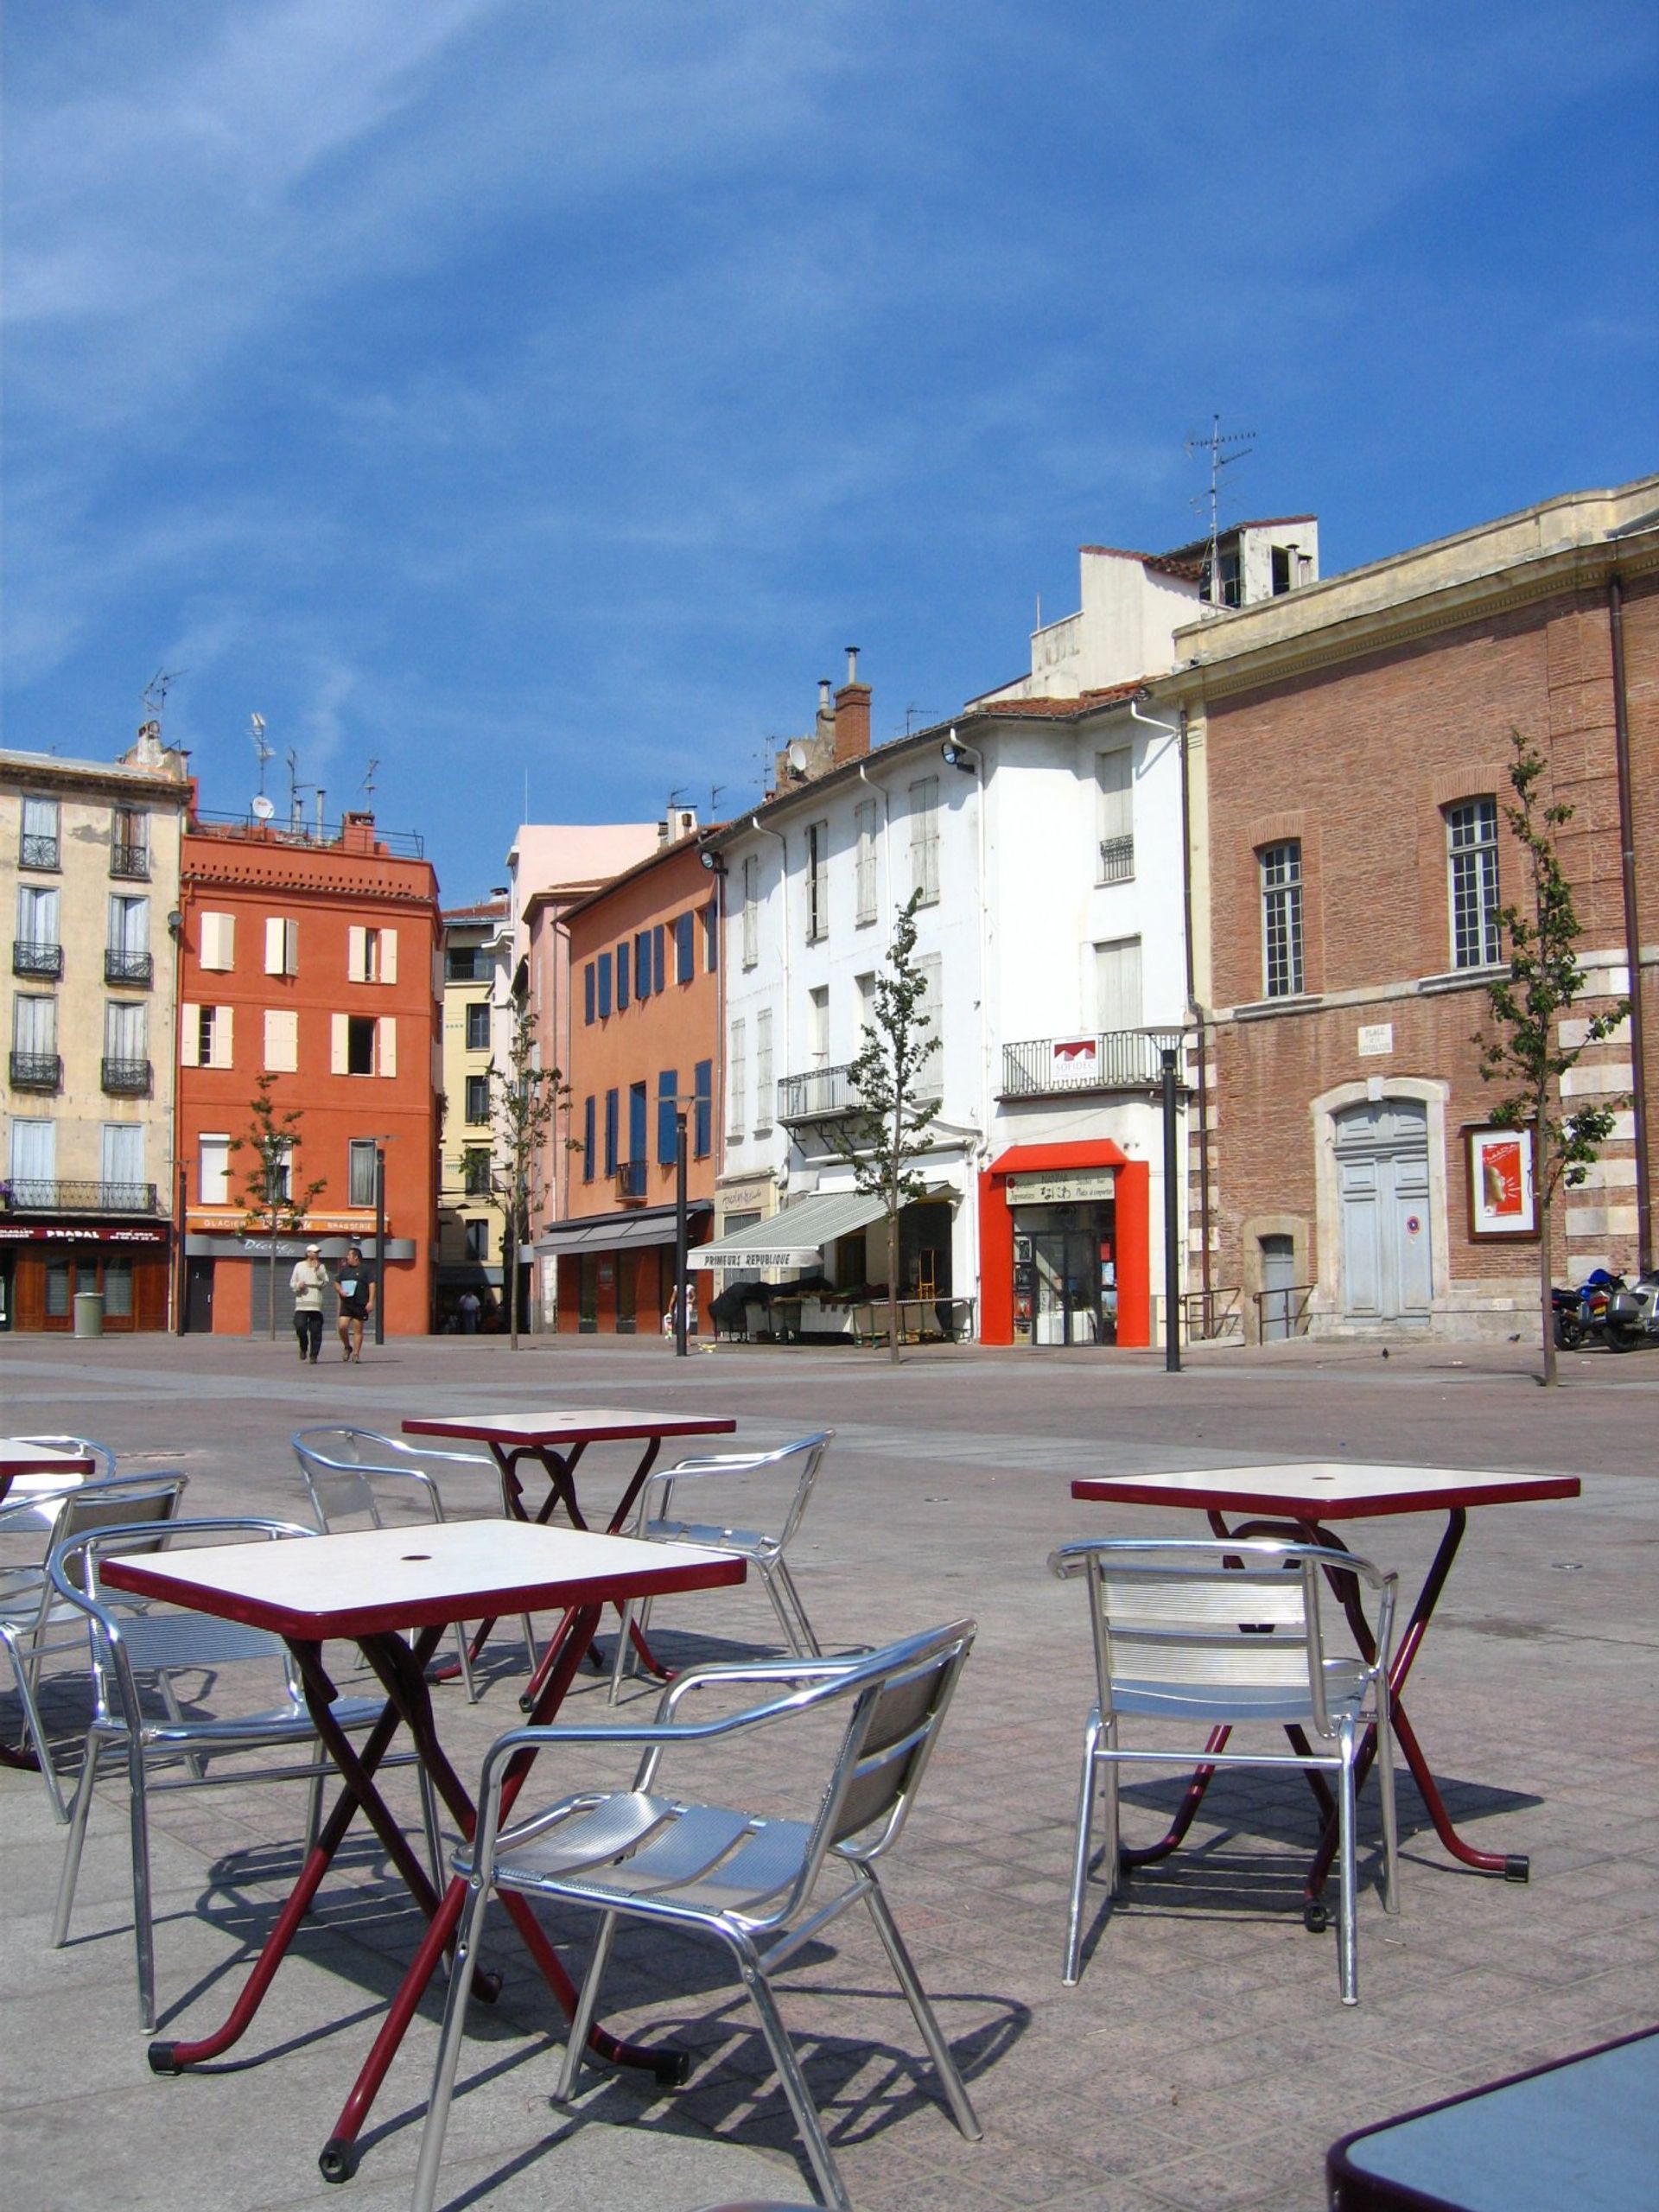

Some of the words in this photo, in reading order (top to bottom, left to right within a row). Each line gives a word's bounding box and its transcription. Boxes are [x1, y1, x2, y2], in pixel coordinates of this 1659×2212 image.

[203, 1219, 246, 1229] GLACIER
[327, 1221, 372, 1230] BRASSERIE
[47, 1230, 100, 1239] PRADAL
[704, 1255, 741, 1266] PRIMEURS
[746, 1253, 791, 1266] REPUBLIQUE
